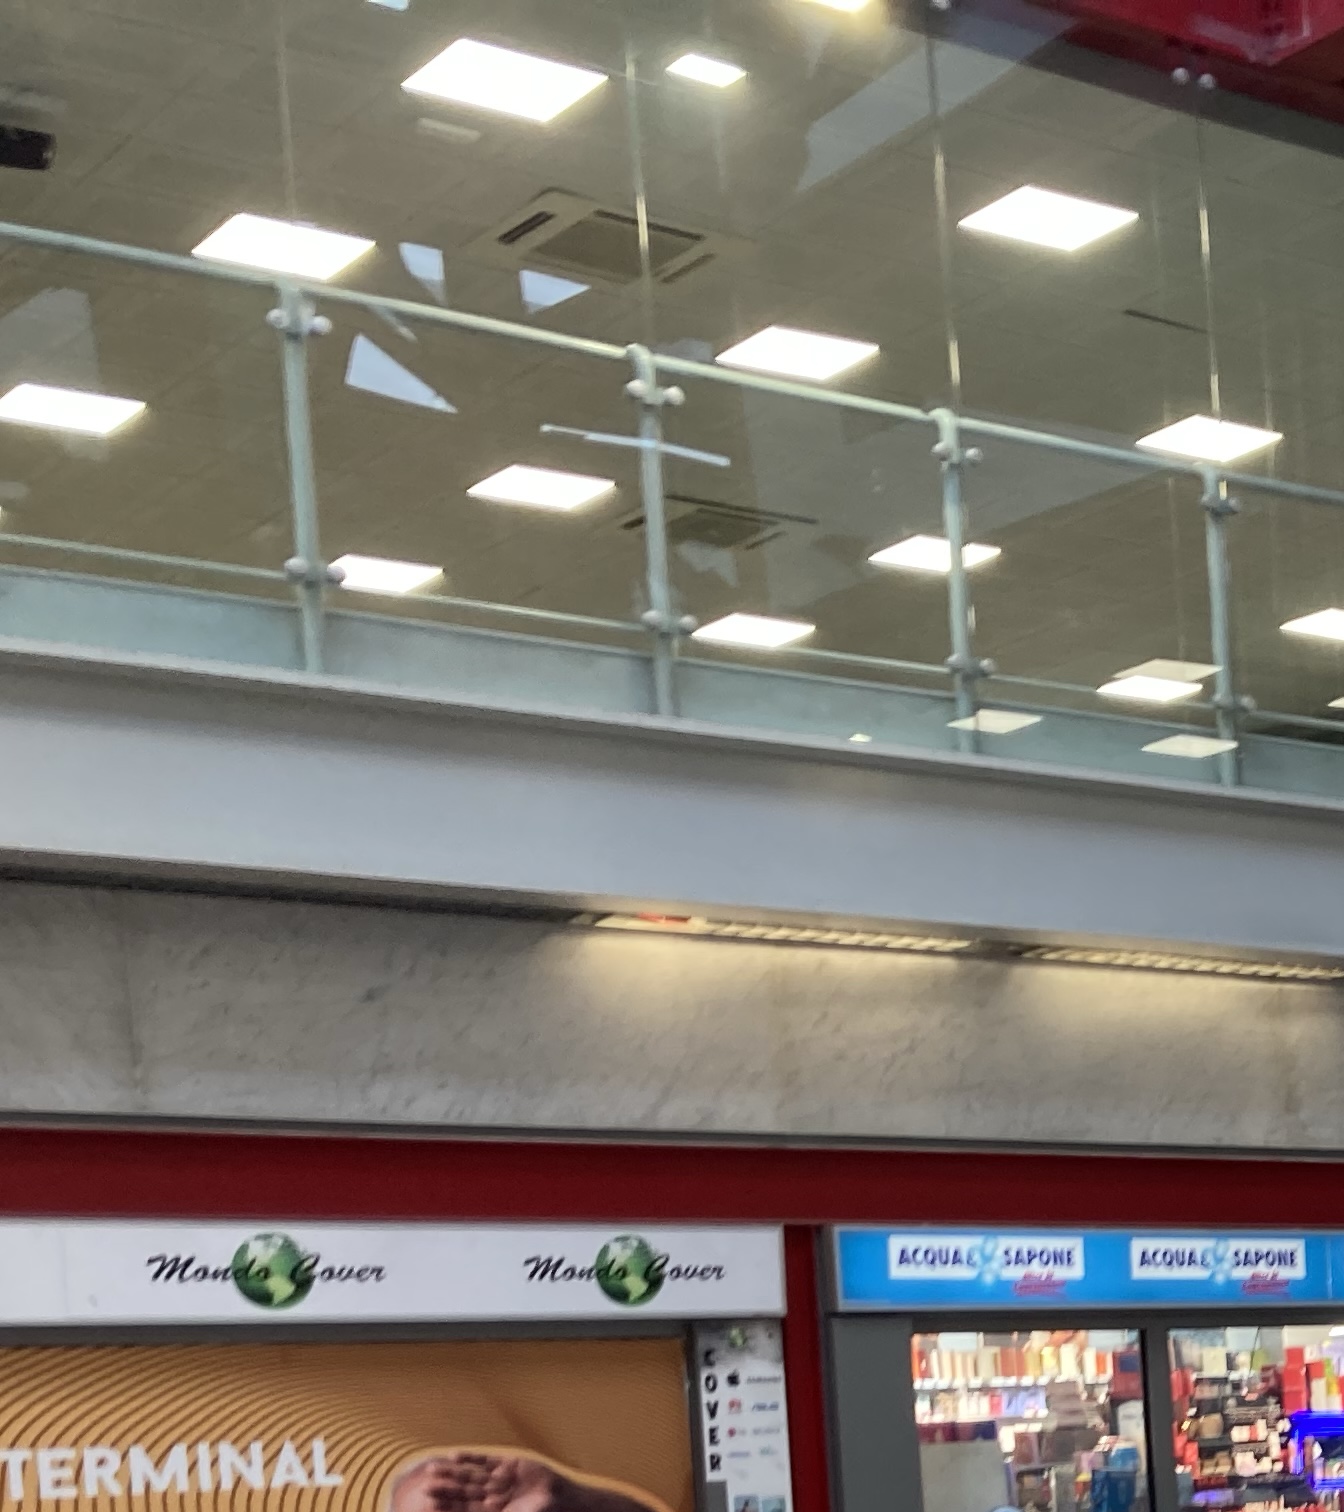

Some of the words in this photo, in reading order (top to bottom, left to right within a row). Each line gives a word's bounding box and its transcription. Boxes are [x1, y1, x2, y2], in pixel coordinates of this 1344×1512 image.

[146, 1253, 271, 1283] Mondo
[290, 1252, 387, 1287] Cover
[523, 1255, 628, 1281] Mondo
[643, 1253, 727, 1284] Cover
[898, 1246, 964, 1270] ACQUA
[1003, 1246, 1077, 1267] SAPONE
[1139, 1247, 1199, 1269] ACQUA
[1234, 1247, 1298, 1267] SAPONE
[0, 1437, 344, 1501] TERMINAL
